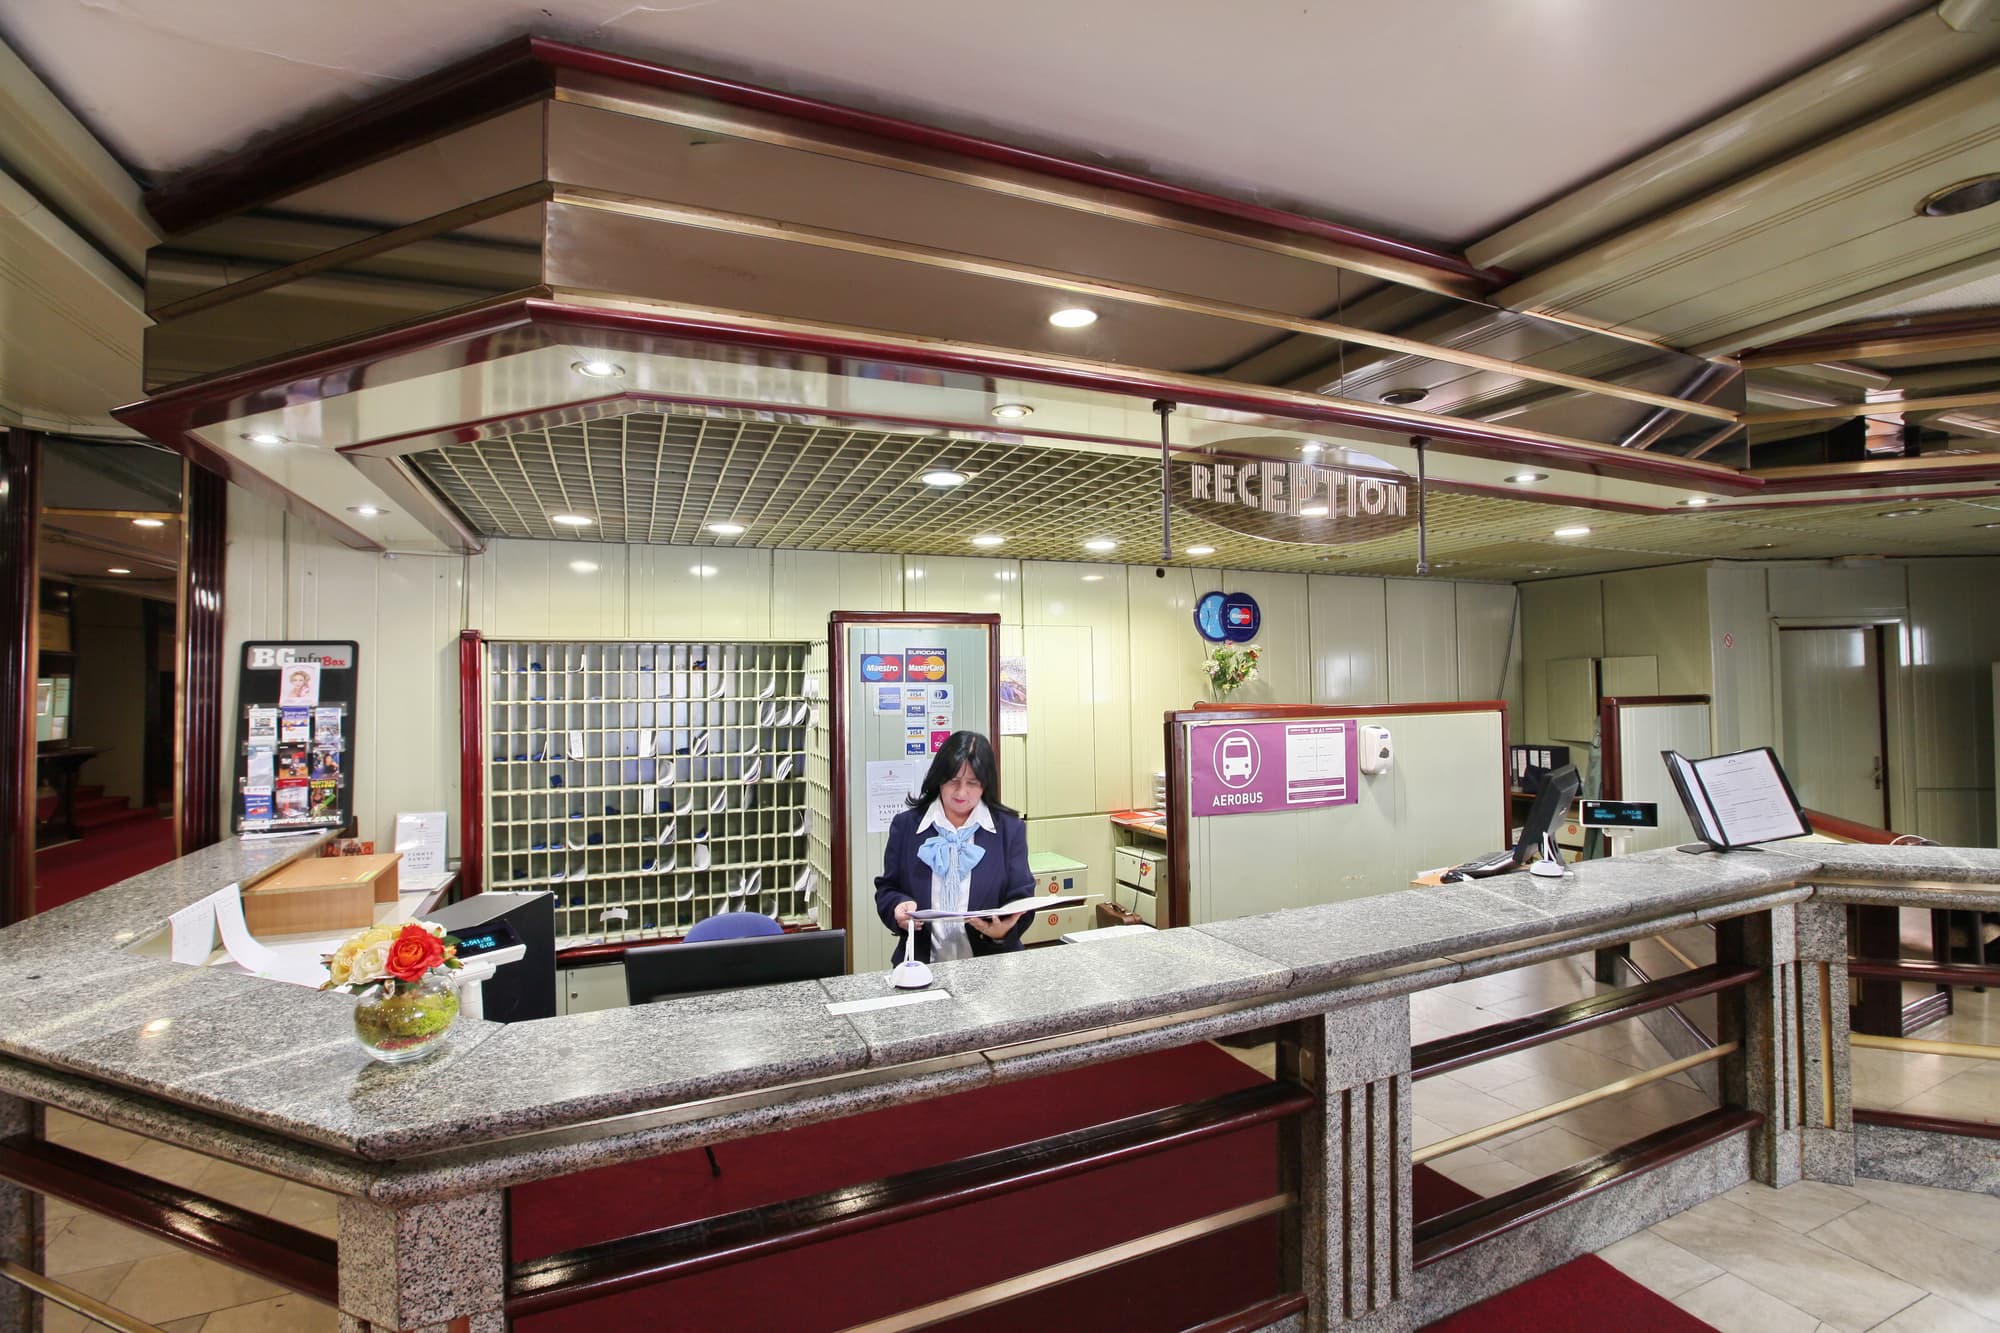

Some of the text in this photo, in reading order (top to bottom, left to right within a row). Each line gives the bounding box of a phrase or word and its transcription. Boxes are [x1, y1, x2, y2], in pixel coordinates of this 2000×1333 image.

[1191, 461, 1407, 520] RECEPTION
[866, 663, 898, 672] Maestro
[908, 663, 945, 672] MasterCard
[1212, 791, 1264, 807] AEROBUS
